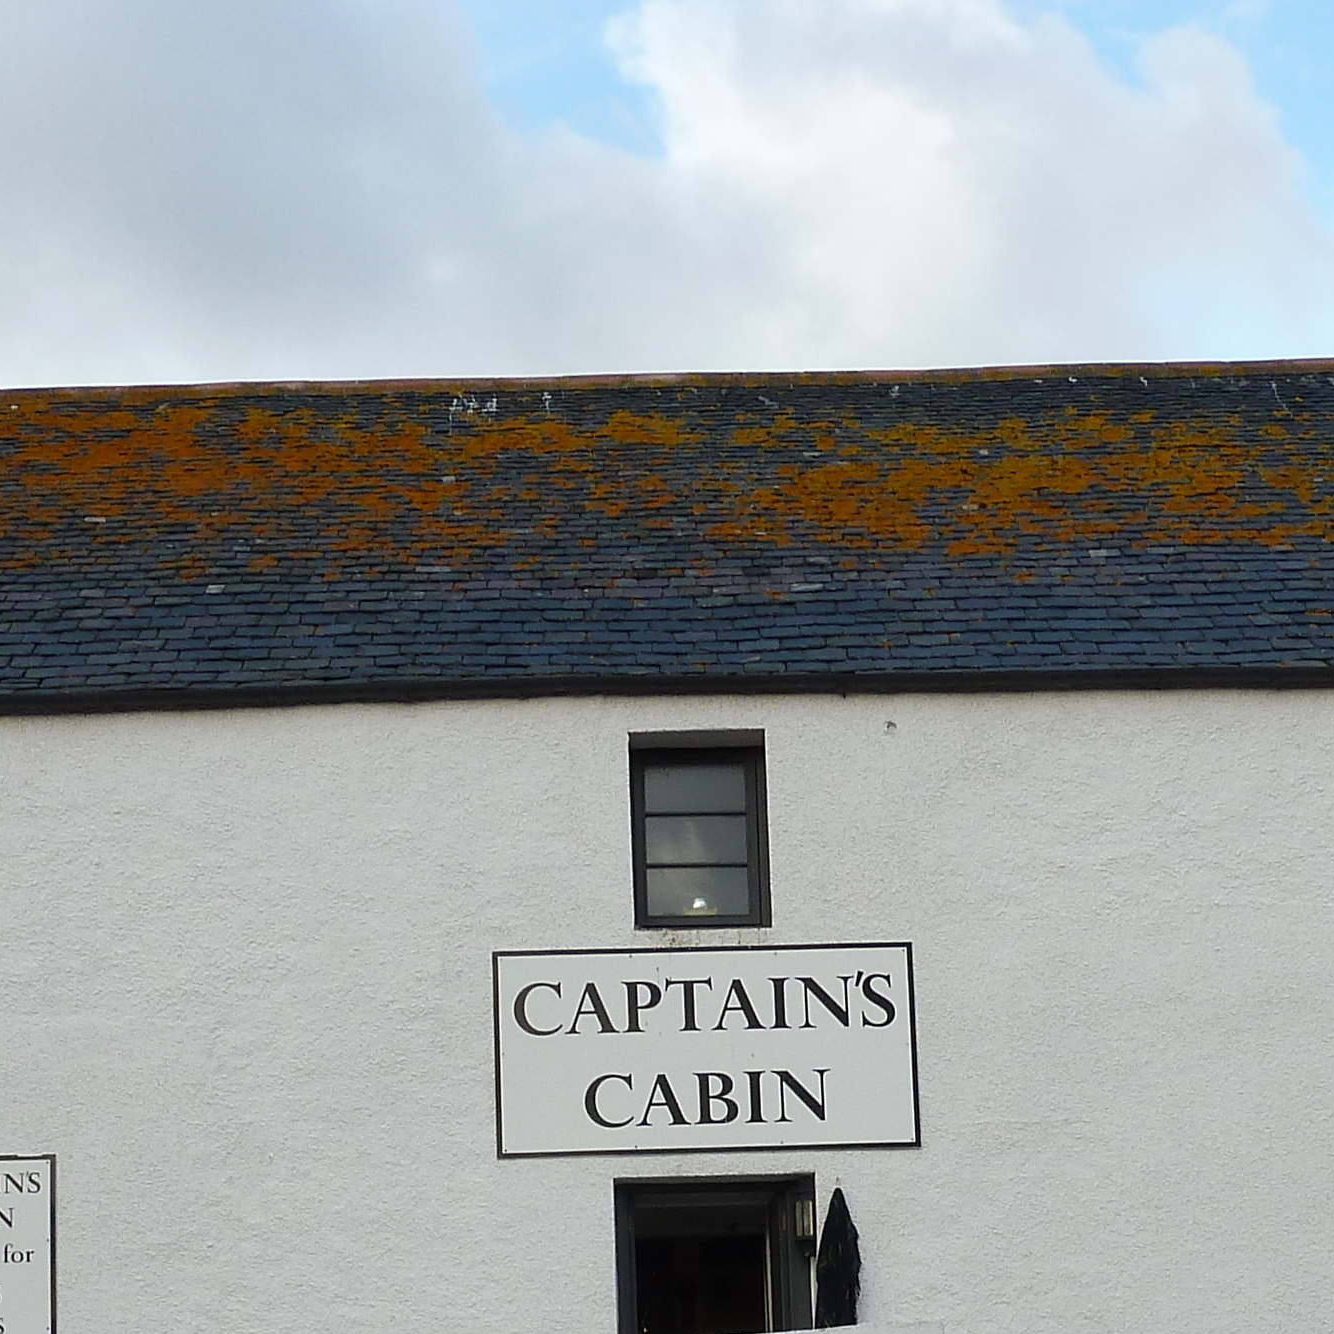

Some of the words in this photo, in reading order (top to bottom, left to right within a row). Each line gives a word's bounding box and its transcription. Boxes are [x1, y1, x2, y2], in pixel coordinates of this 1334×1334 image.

[513, 971, 896, 1036] CAPTAIN'S
[584, 1068, 831, 1128] CABIN
[3, 1244, 35, 1264] for
